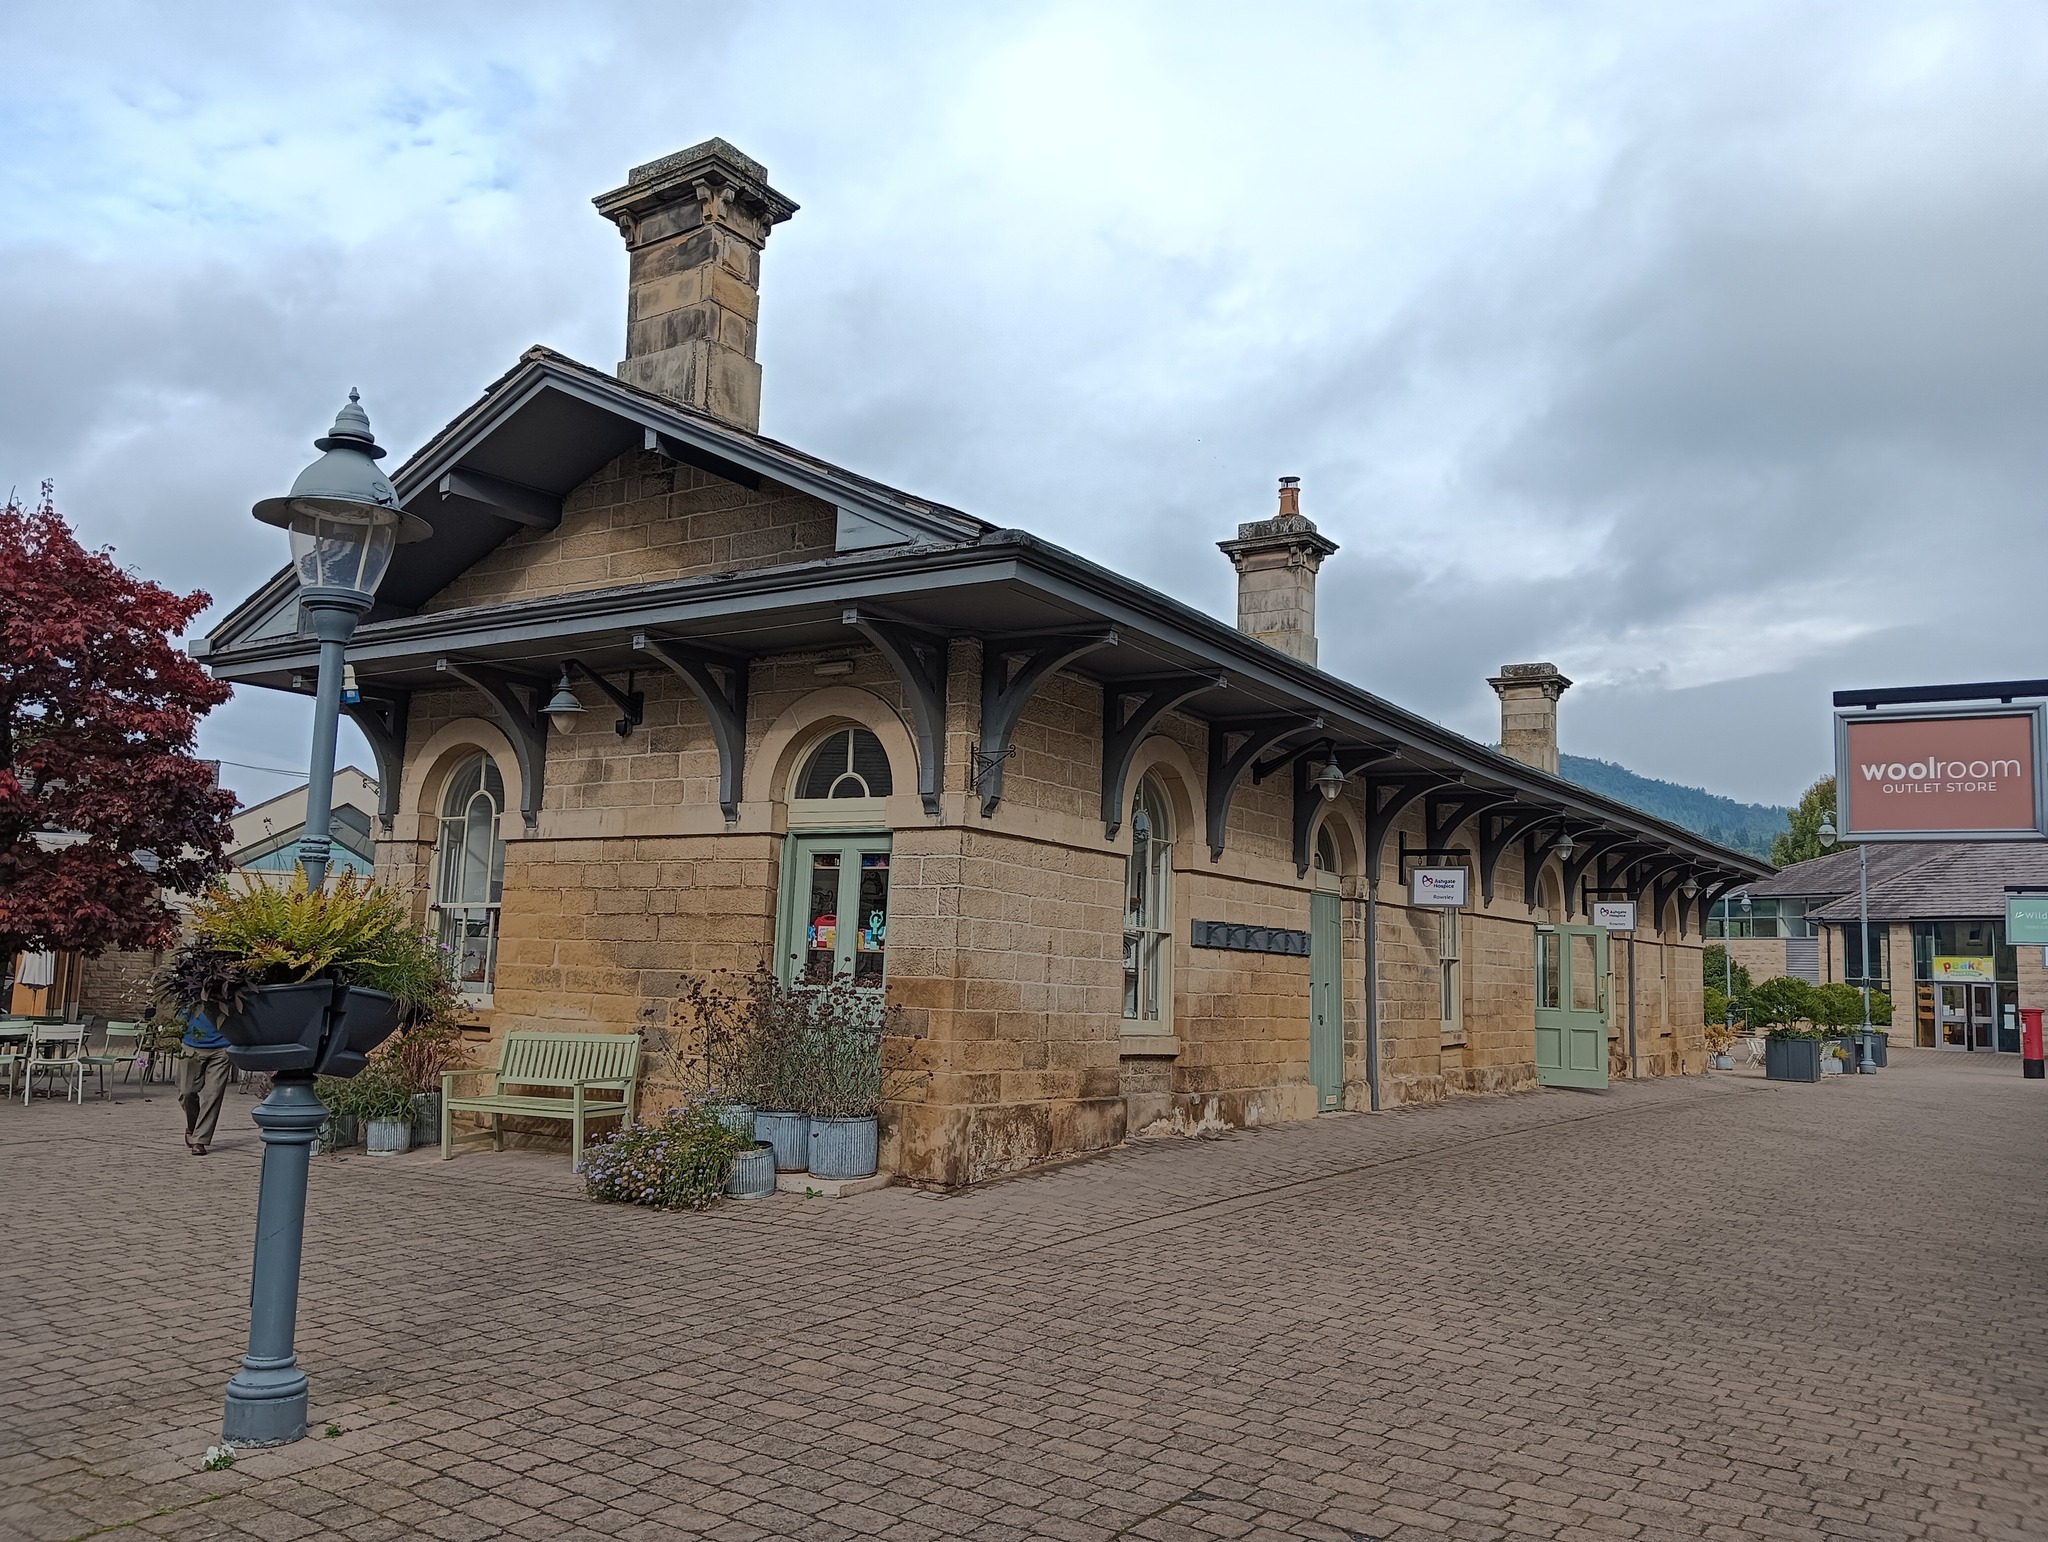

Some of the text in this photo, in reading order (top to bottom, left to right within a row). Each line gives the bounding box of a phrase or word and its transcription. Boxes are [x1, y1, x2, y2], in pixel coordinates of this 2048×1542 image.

[1861, 756, 2021, 781] woolroom
[1883, 781, 1997, 794] OUTLET STORE
[1943, 961, 1975, 973] peak
